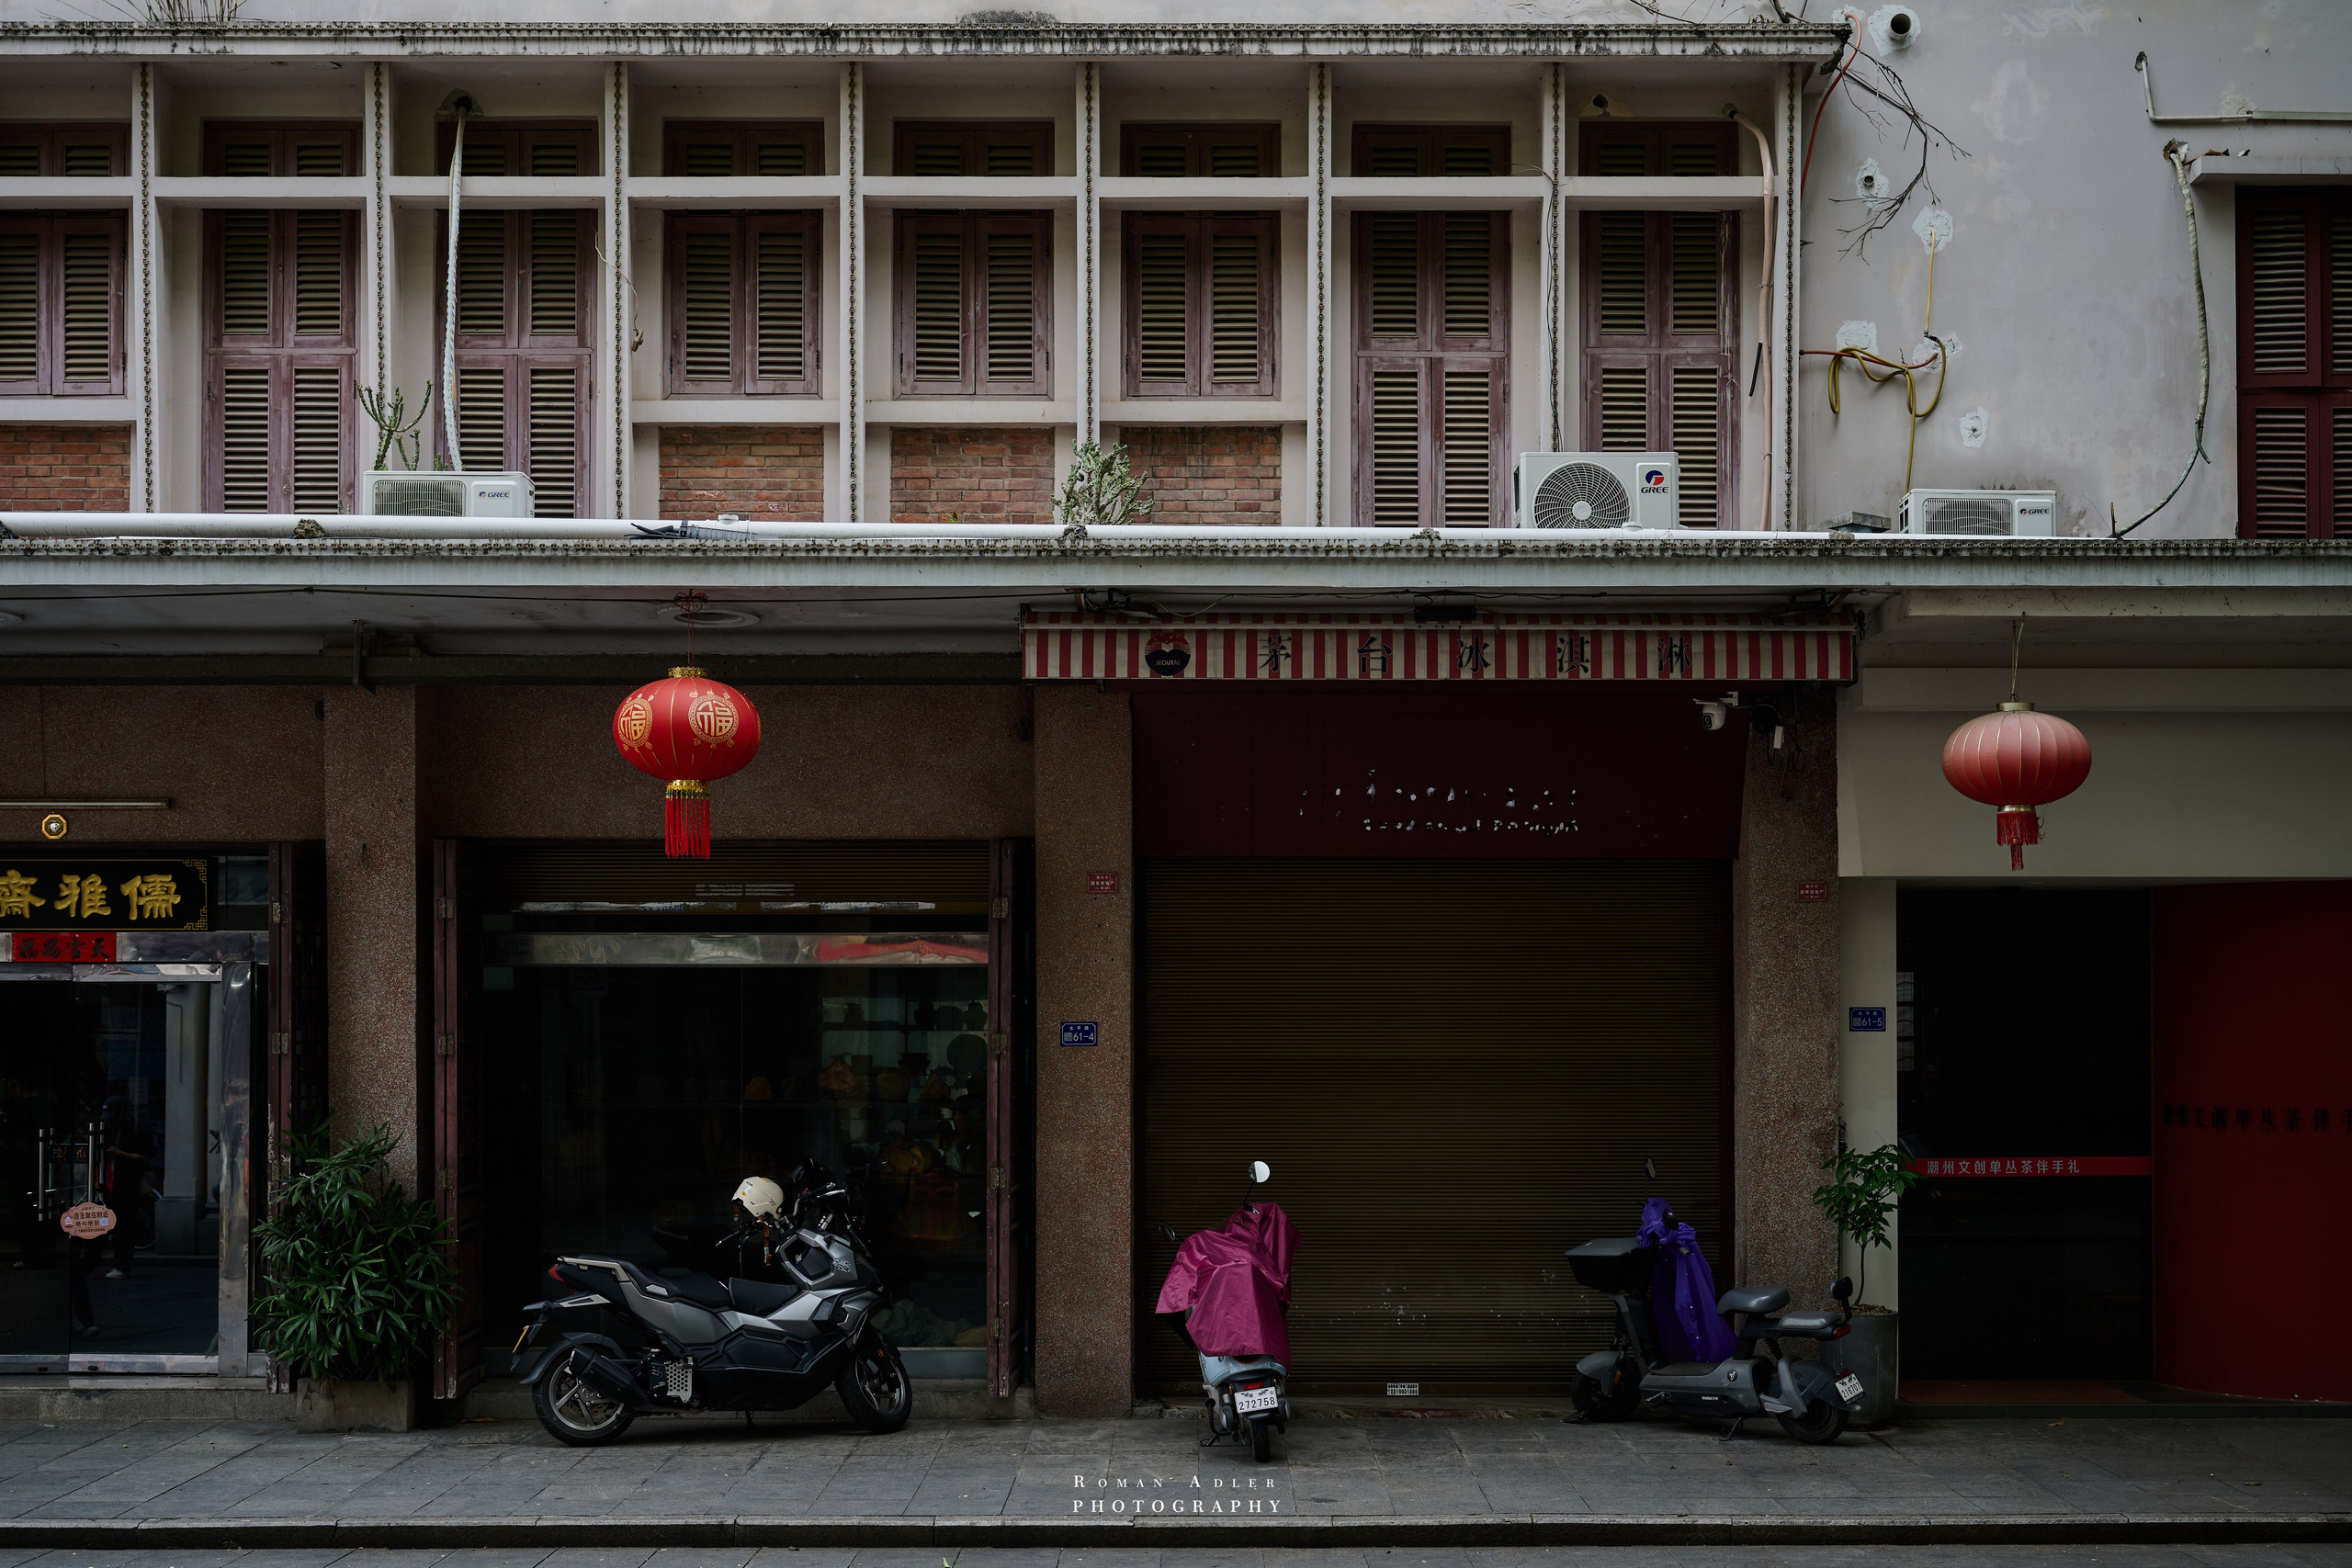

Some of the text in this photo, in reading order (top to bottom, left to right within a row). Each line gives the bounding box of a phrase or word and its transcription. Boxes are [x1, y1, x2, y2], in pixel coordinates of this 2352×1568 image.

[1258, 635, 1692, 673] 茅台冰淇淋
[620, 704, 647, 741] 福
[696, 700, 734, 737] 福
[1861, 1017, 1883, 1027] 61-5
[1073, 1032, 1094, 1042] 61-4
[1927, 1159, 2080, 1175] 潮州文创单丛茶伴手礼
[1841, 1382, 1861, 1398] 216707
[1238, 1396, 1275, 1411] 272758
